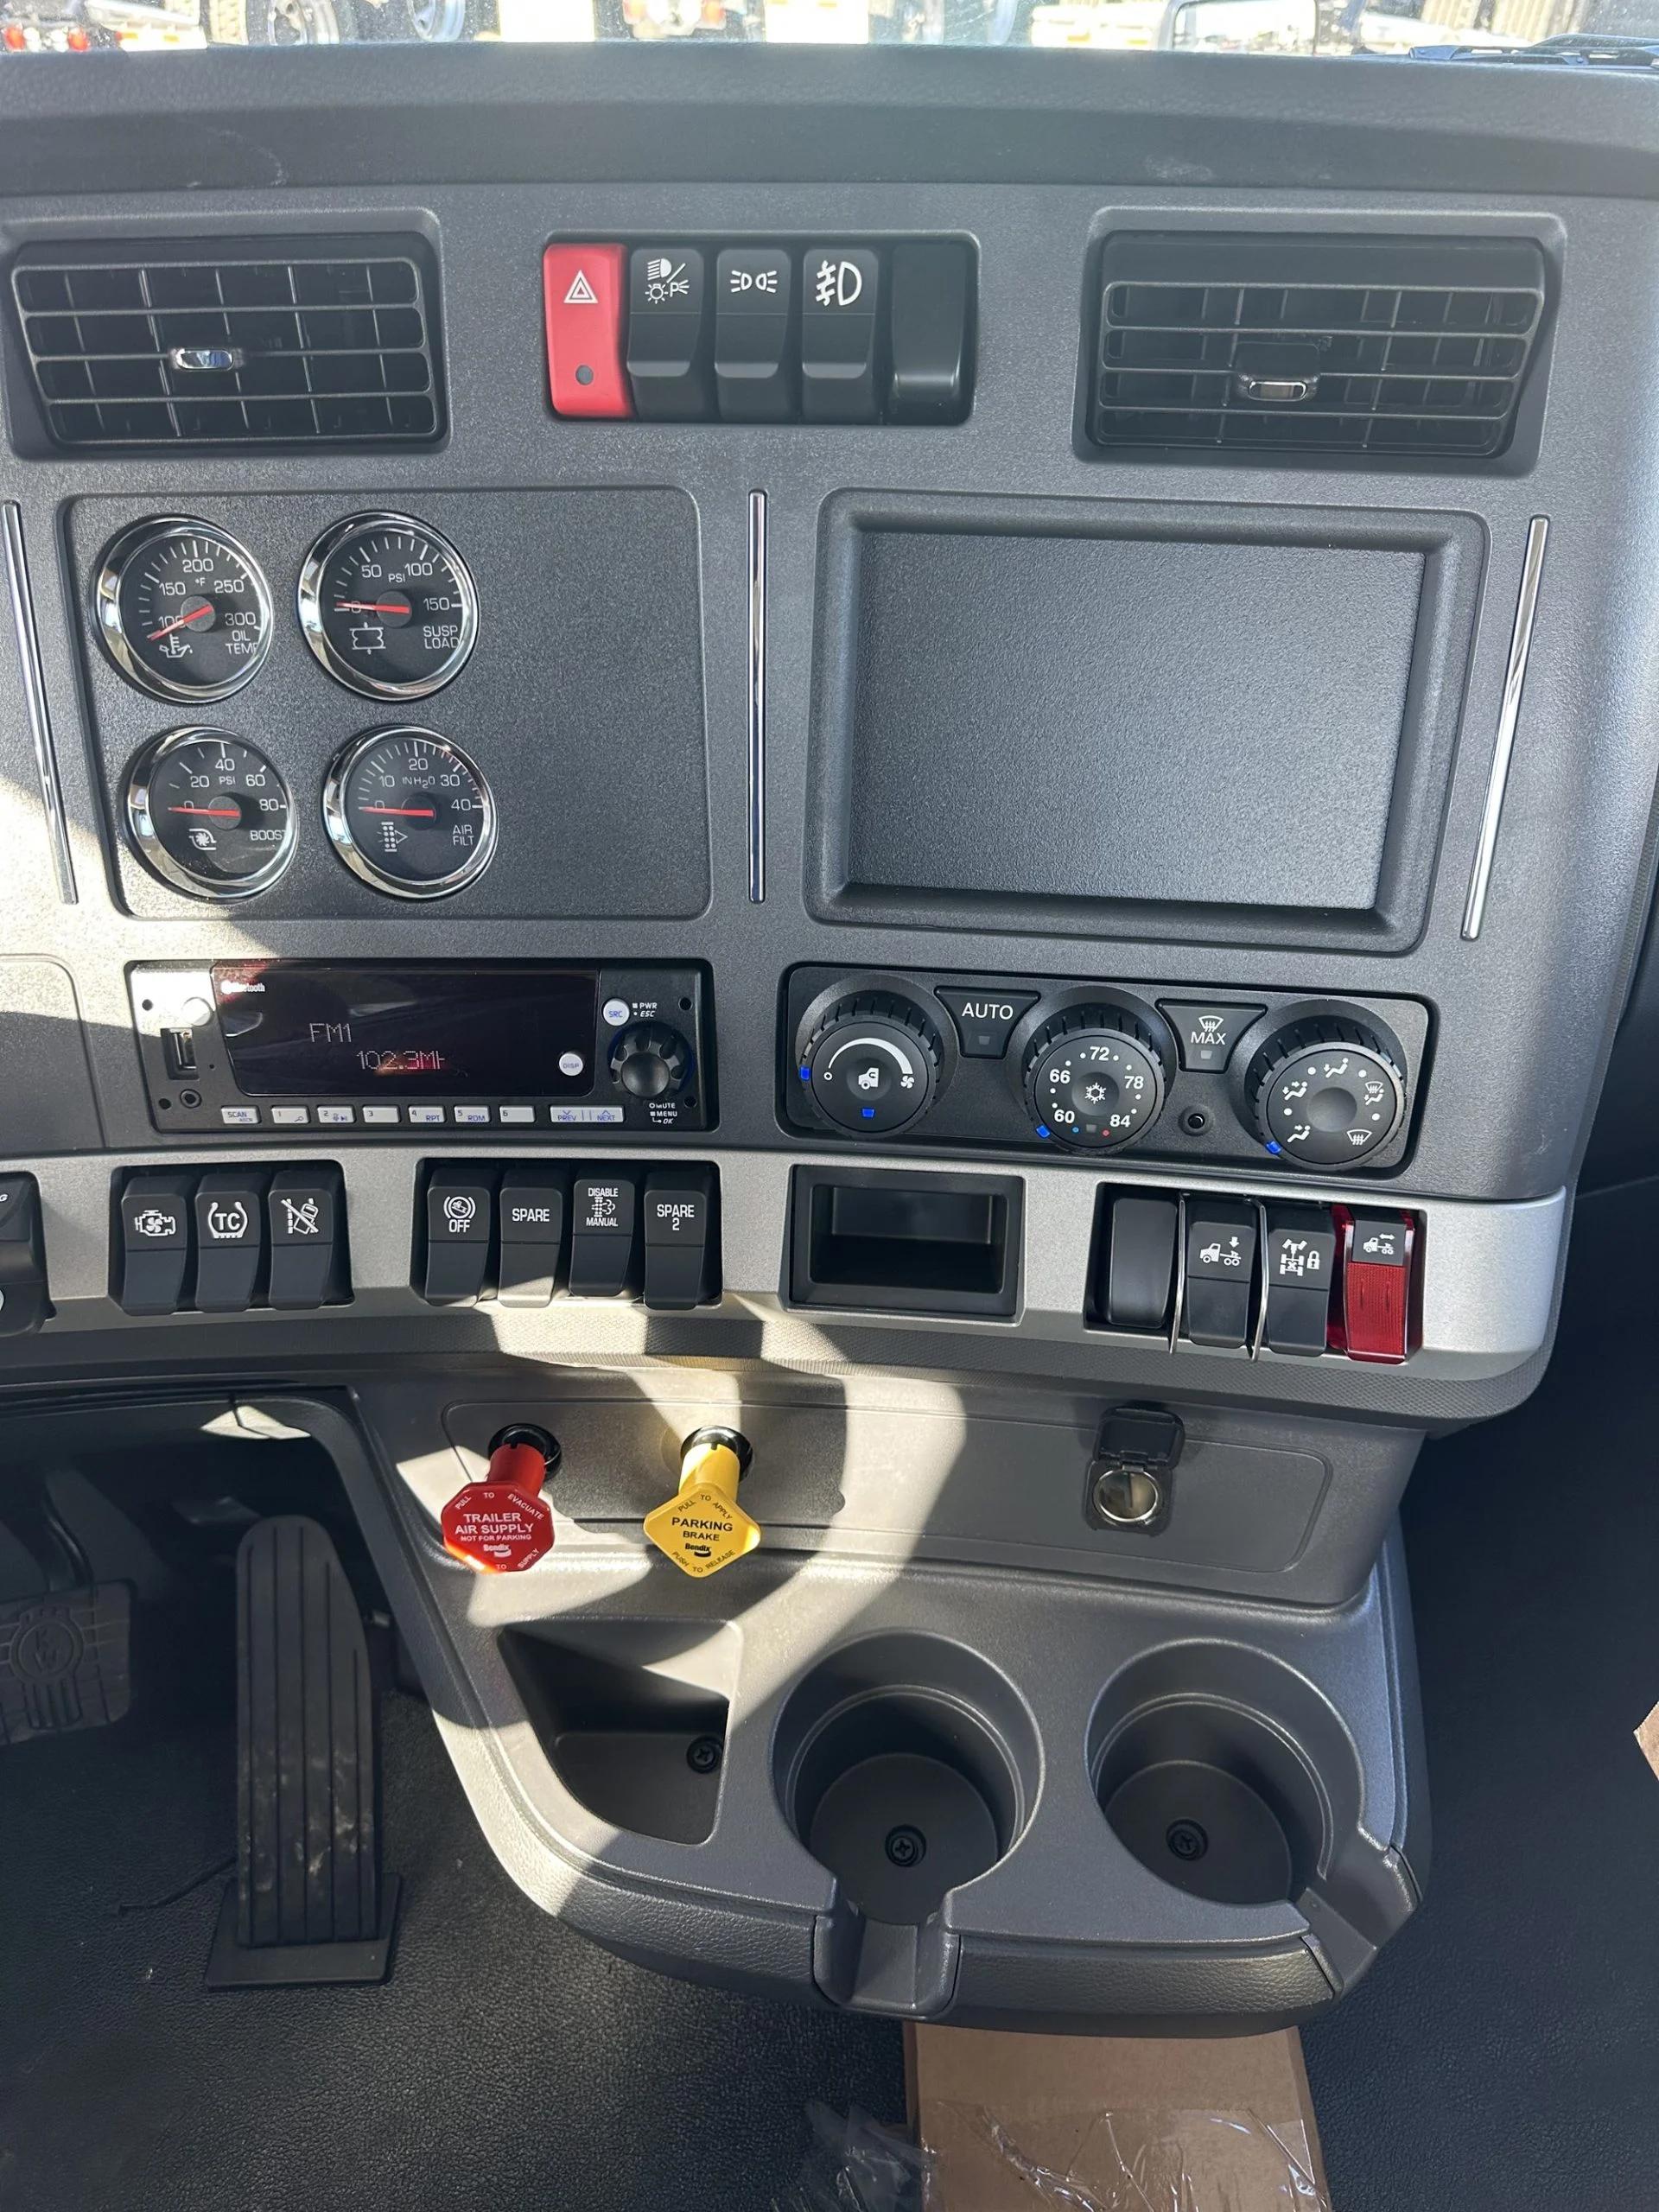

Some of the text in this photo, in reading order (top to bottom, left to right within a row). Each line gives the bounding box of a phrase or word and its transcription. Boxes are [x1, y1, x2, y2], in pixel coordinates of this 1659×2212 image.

[182, 559, 213, 573] 200
[361, 564, 382, 578] 50
[404, 563, 433, 576] 100
[388, 573, 405, 583] PSI
[159, 582, 186, 595] 150
[214, 580, 245, 594] 250
[423, 597, 449, 611] 150
[225, 612, 256, 626] 300
[232, 630, 251, 641] OIL
[423, 625, 458, 638] SUSP
[424, 637, 461, 649] LOAD
[215, 759, 235, 771] 40
[409, 758, 429, 771] 20
[190, 775, 210, 788] 20
[219, 777, 236, 785] PSI
[245, 774, 265, 786] 60
[381, 775, 395, 787] 10
[441, 774, 461, 787] 30
[259, 798, 278, 811] 80
[451, 798, 471, 811] 40
[453, 824, 473, 835] AIR
[453, 836, 474, 846] FILT
[962, 1002, 1014, 1020] AUTO
[309, 1023, 352, 1043] FM1
[1191, 1032, 1226, 1046] MAX
[1090, 1046, 1109, 1061] 72
[1049, 1069, 1071, 1084] 66
[1124, 1075, 1144, 1090] 78
[1054, 1109, 1075, 1123] 60
[1109, 1114, 1131, 1128] 84
[588, 1187, 619, 1198] DISABLE
[512, 1208, 550, 1223] SPARE
[657, 1204, 695, 1219] SPARE
[215, 1212, 240, 1230] TC
[448, 1219, 470, 1233] OFF
[586, 1217, 619, 1227] MANUAL
[672, 1217, 680, 1231] 2
[454, 1496, 472, 1510] PULL
[507, 1493, 544, 1520] EVACUATE
[677, 1500, 696, 1512] PULL
[713, 1502, 733, 1520] APPLY
[463, 1512, 521, 1522] TRAILER
[455, 1523, 533, 1535] AIR SUPPLY
[671, 1516, 734, 1532] PARKING
[683, 1530, 720, 1541] BRAKE
[684, 1542, 711, 1552] Bendix
[518, 1548, 539, 1568] SUPPLY
[672, 1551, 690, 1567] PUSH
[705, 1549, 735, 1569] RELEASE
